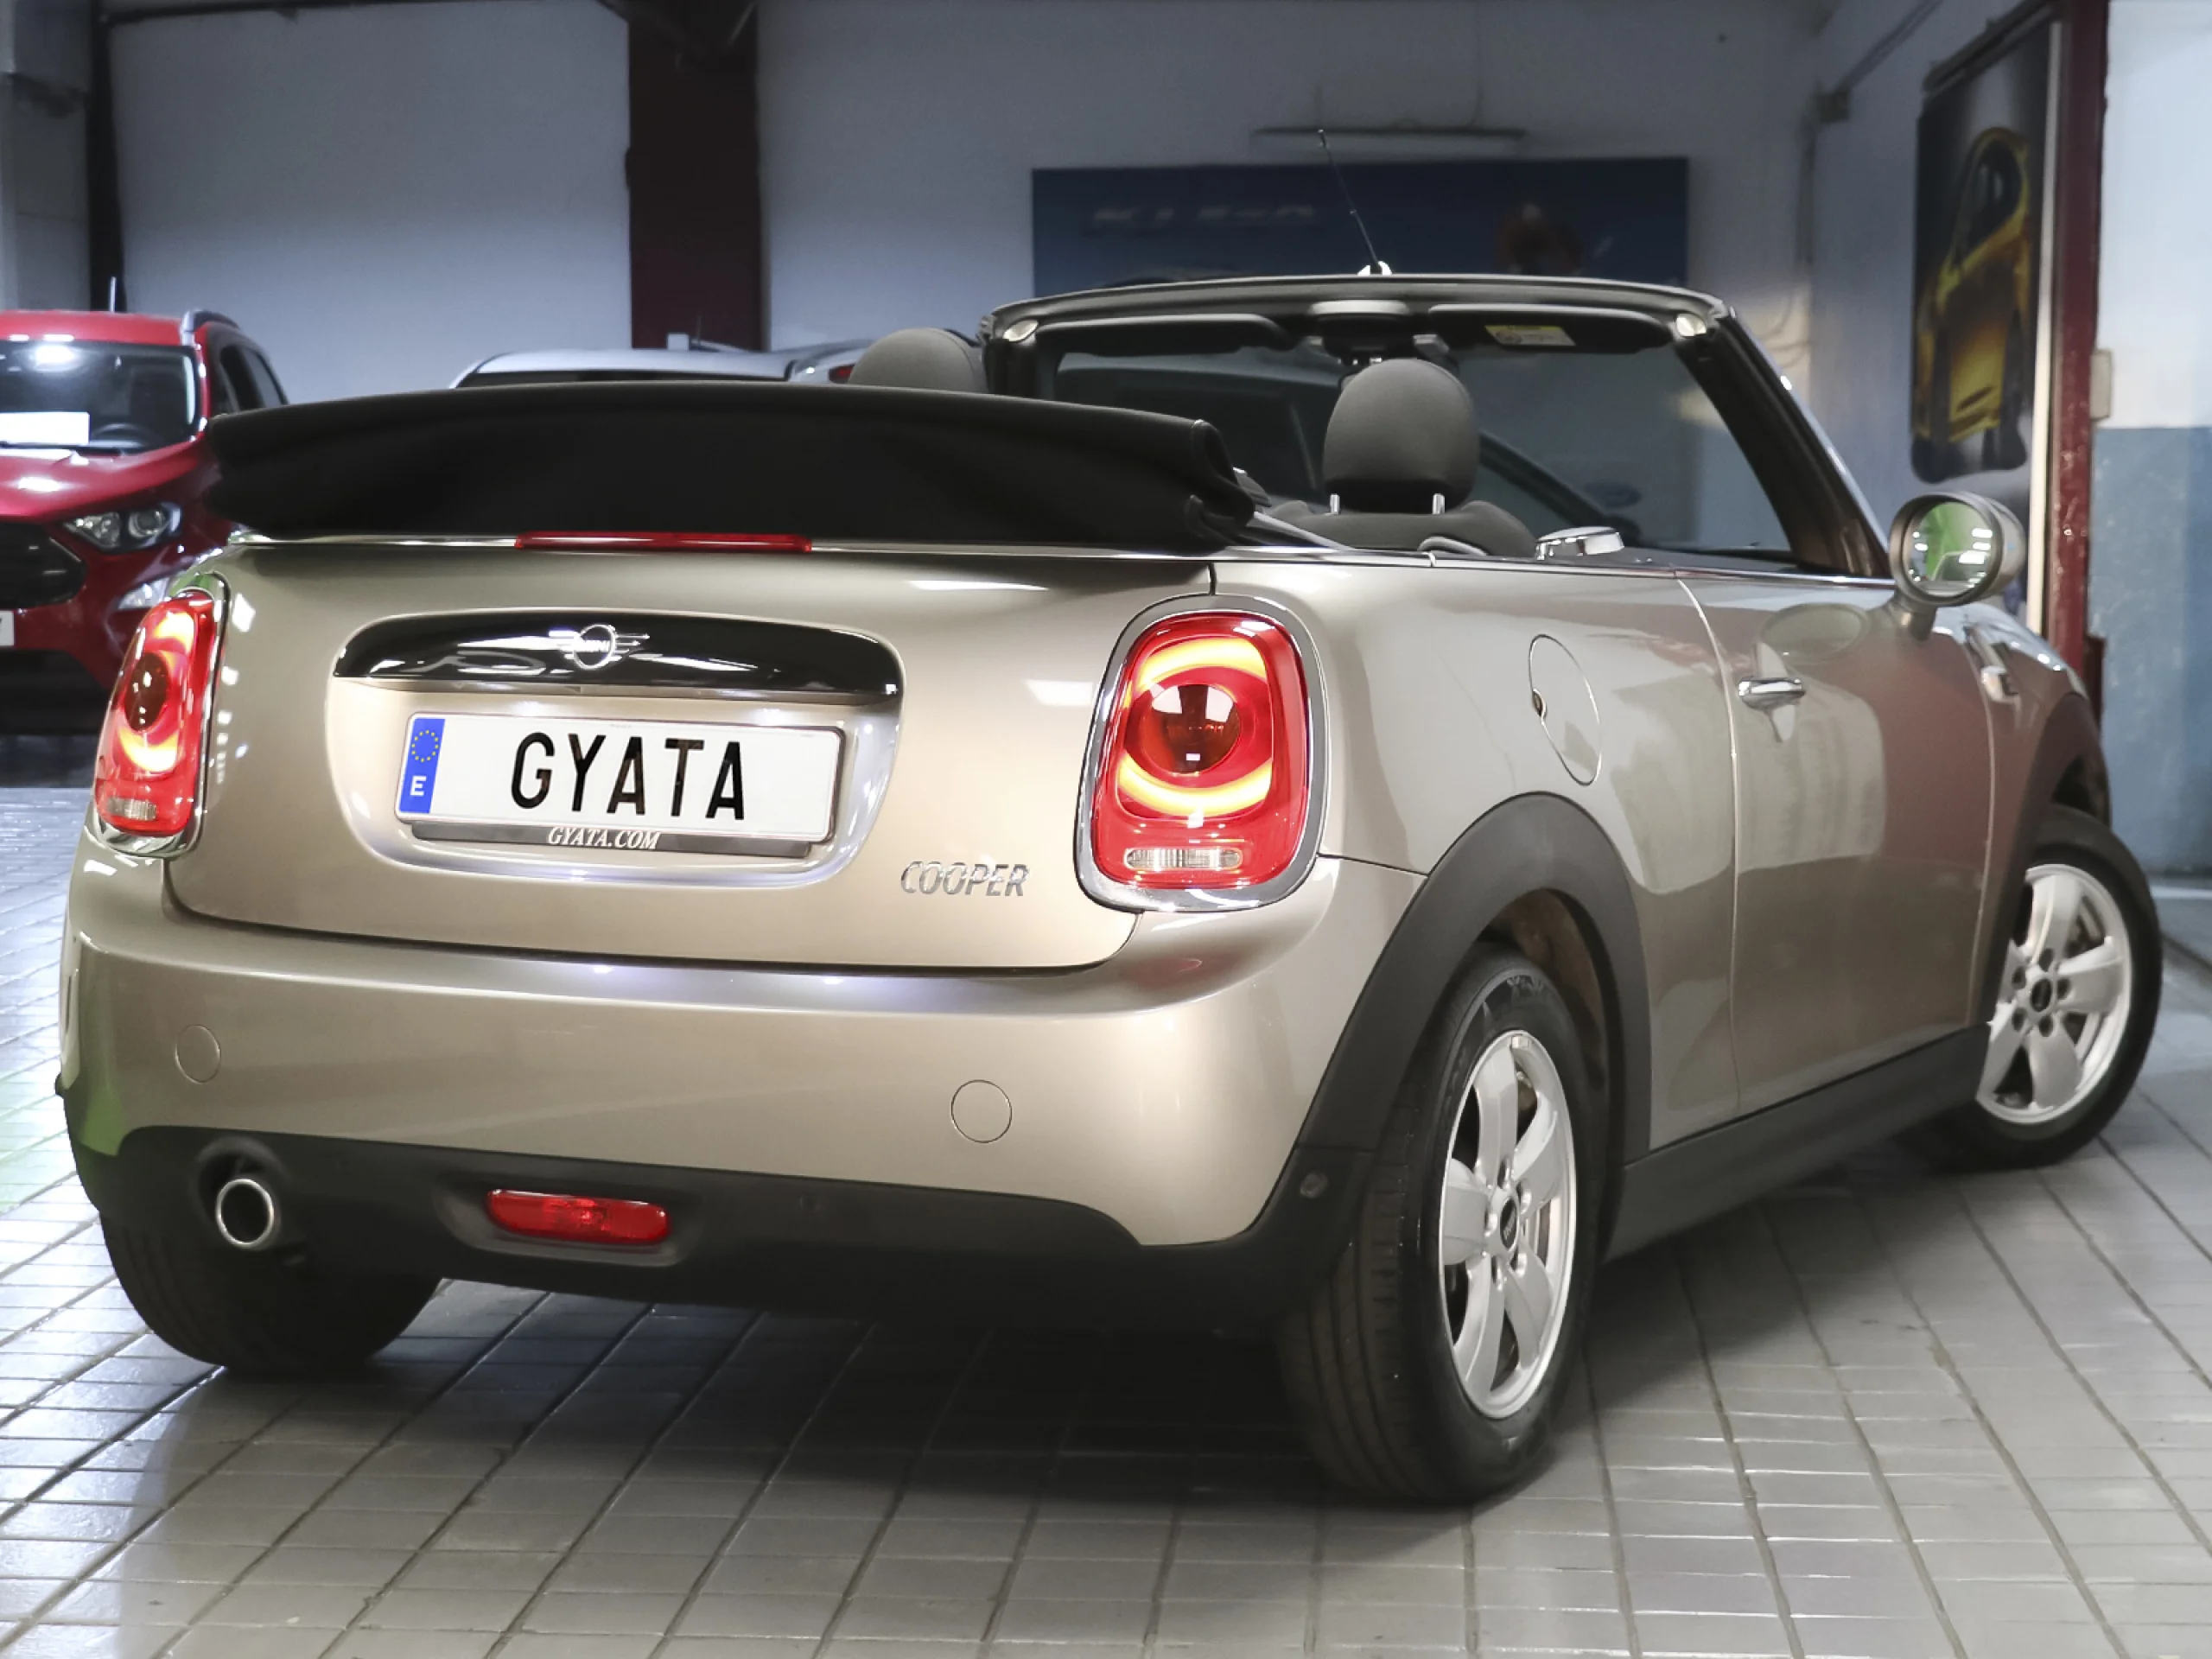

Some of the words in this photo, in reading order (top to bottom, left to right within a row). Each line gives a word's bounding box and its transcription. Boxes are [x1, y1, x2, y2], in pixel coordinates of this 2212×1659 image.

[410, 775, 427, 797] E
[511, 732, 745, 821] GYATA
[548, 827, 661, 849] GYATA.COM
[900, 861, 1029, 897] COOPER
